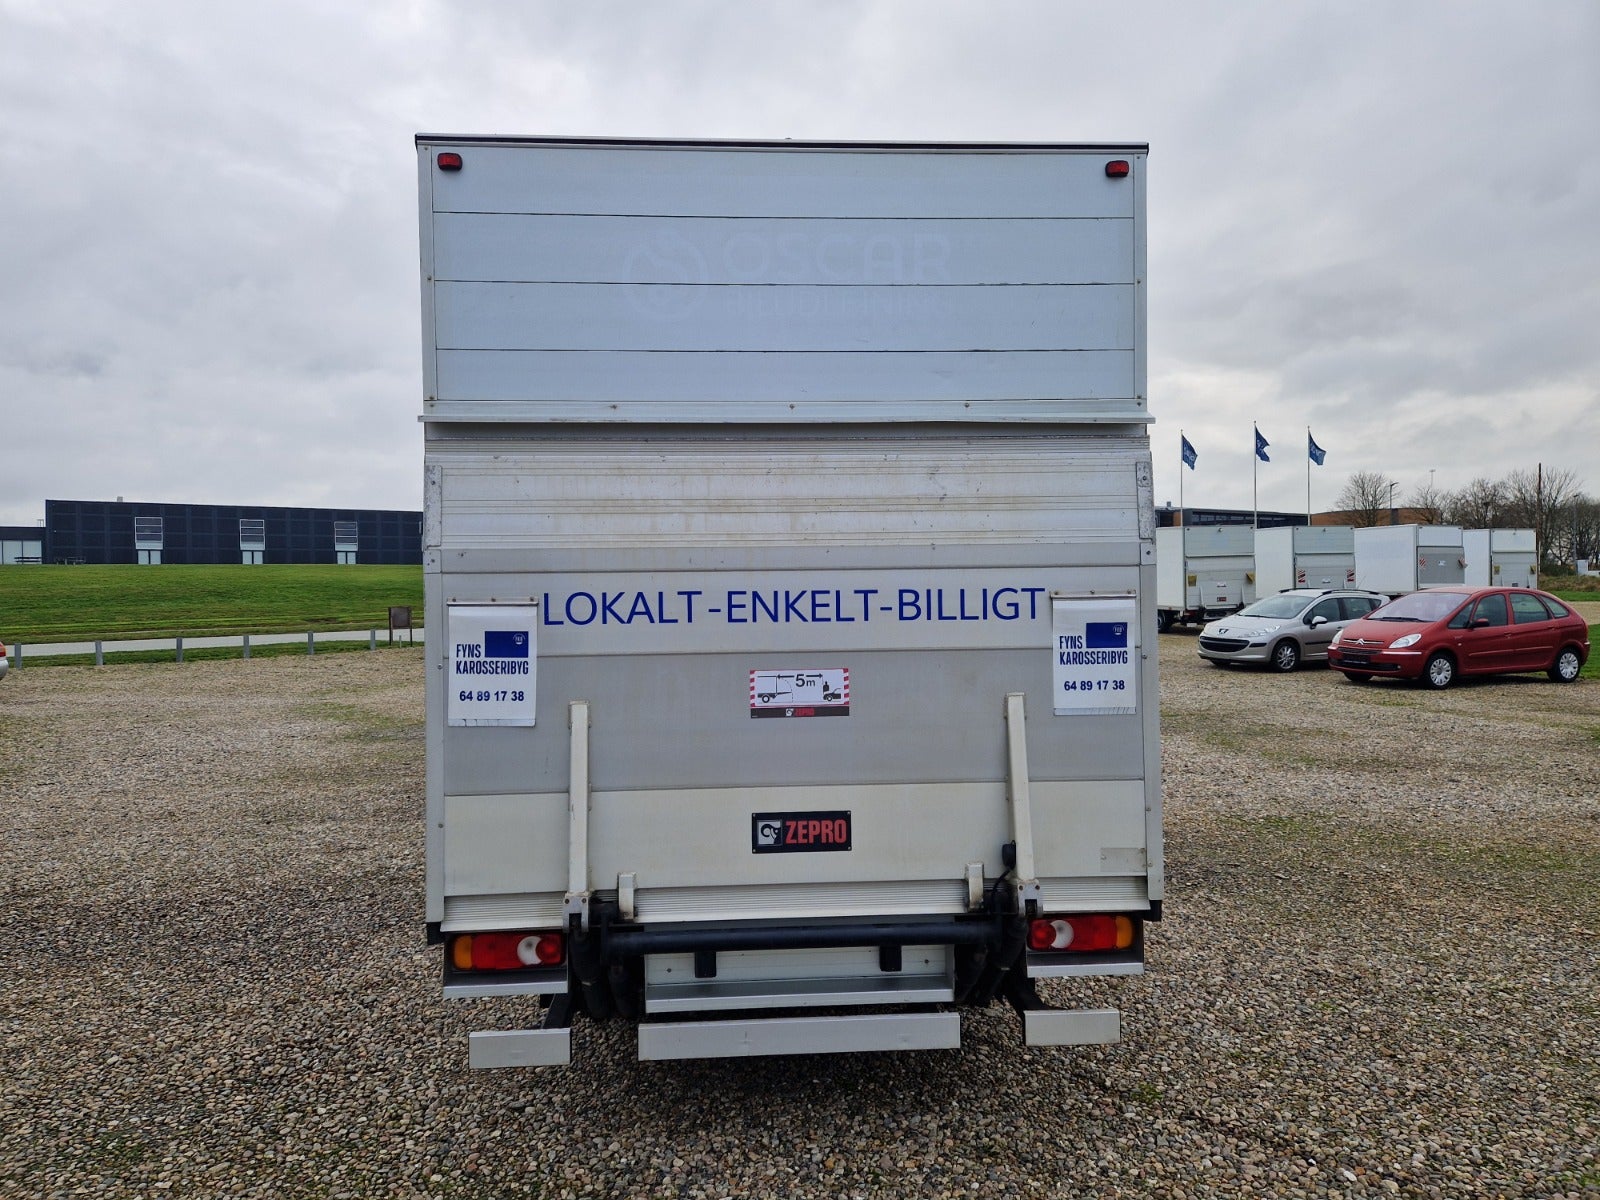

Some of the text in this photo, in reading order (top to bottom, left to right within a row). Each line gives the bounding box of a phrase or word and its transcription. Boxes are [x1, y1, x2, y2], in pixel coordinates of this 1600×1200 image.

[722, 231, 952, 282] OSCAR
[543, 587, 1046, 626] LOKALT-ENKELT-BILLIGT
[1059, 635, 1083, 649] FYNS
[456, 643, 482, 658] FYNS
[1059, 650, 1128, 665] KAROSSERIBYG
[456, 660, 529, 675] KAROSSERIBYG
[1063, 679, 1125, 691] 64 89 17 38
[459, 690, 525, 702] 64 89 17 38
[785, 819, 847, 845] ZEPRO
